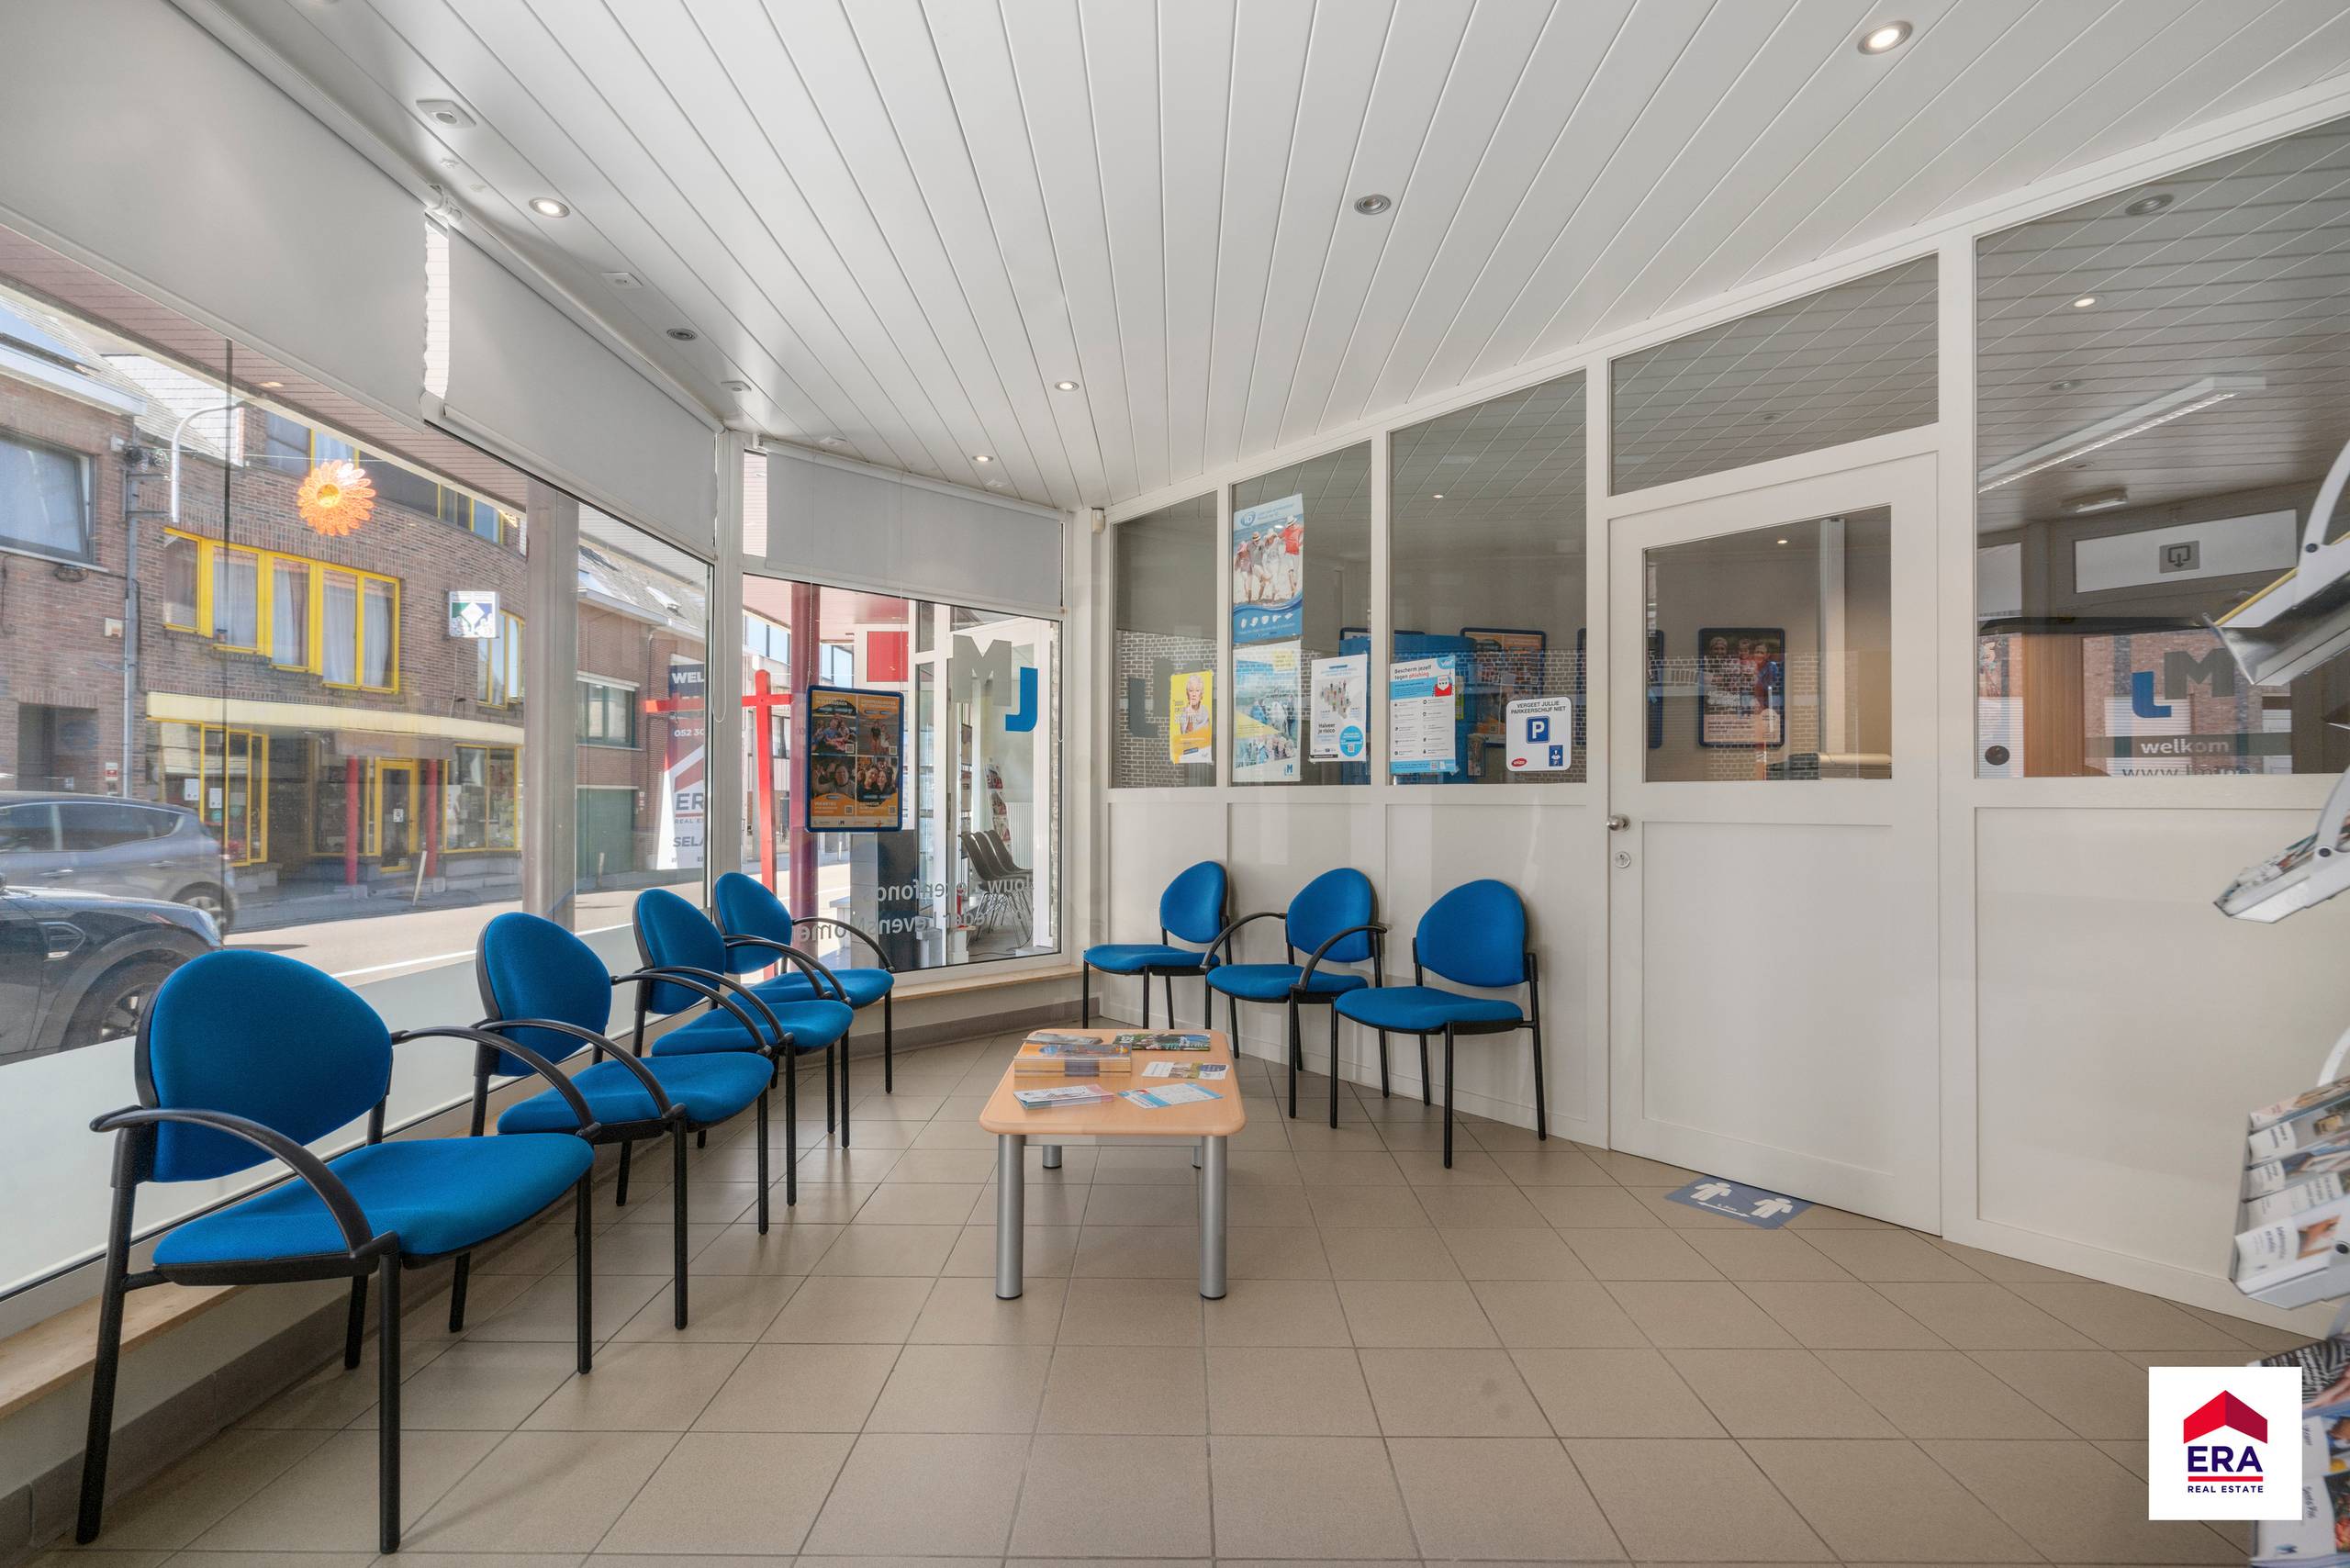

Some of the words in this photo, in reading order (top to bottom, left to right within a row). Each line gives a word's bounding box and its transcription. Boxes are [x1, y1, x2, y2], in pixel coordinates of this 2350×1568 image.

[1418, 664, 1432, 672] jezelf
[1532, 721, 1545, 739] P
[2141, 738, 2230, 754] welkom
